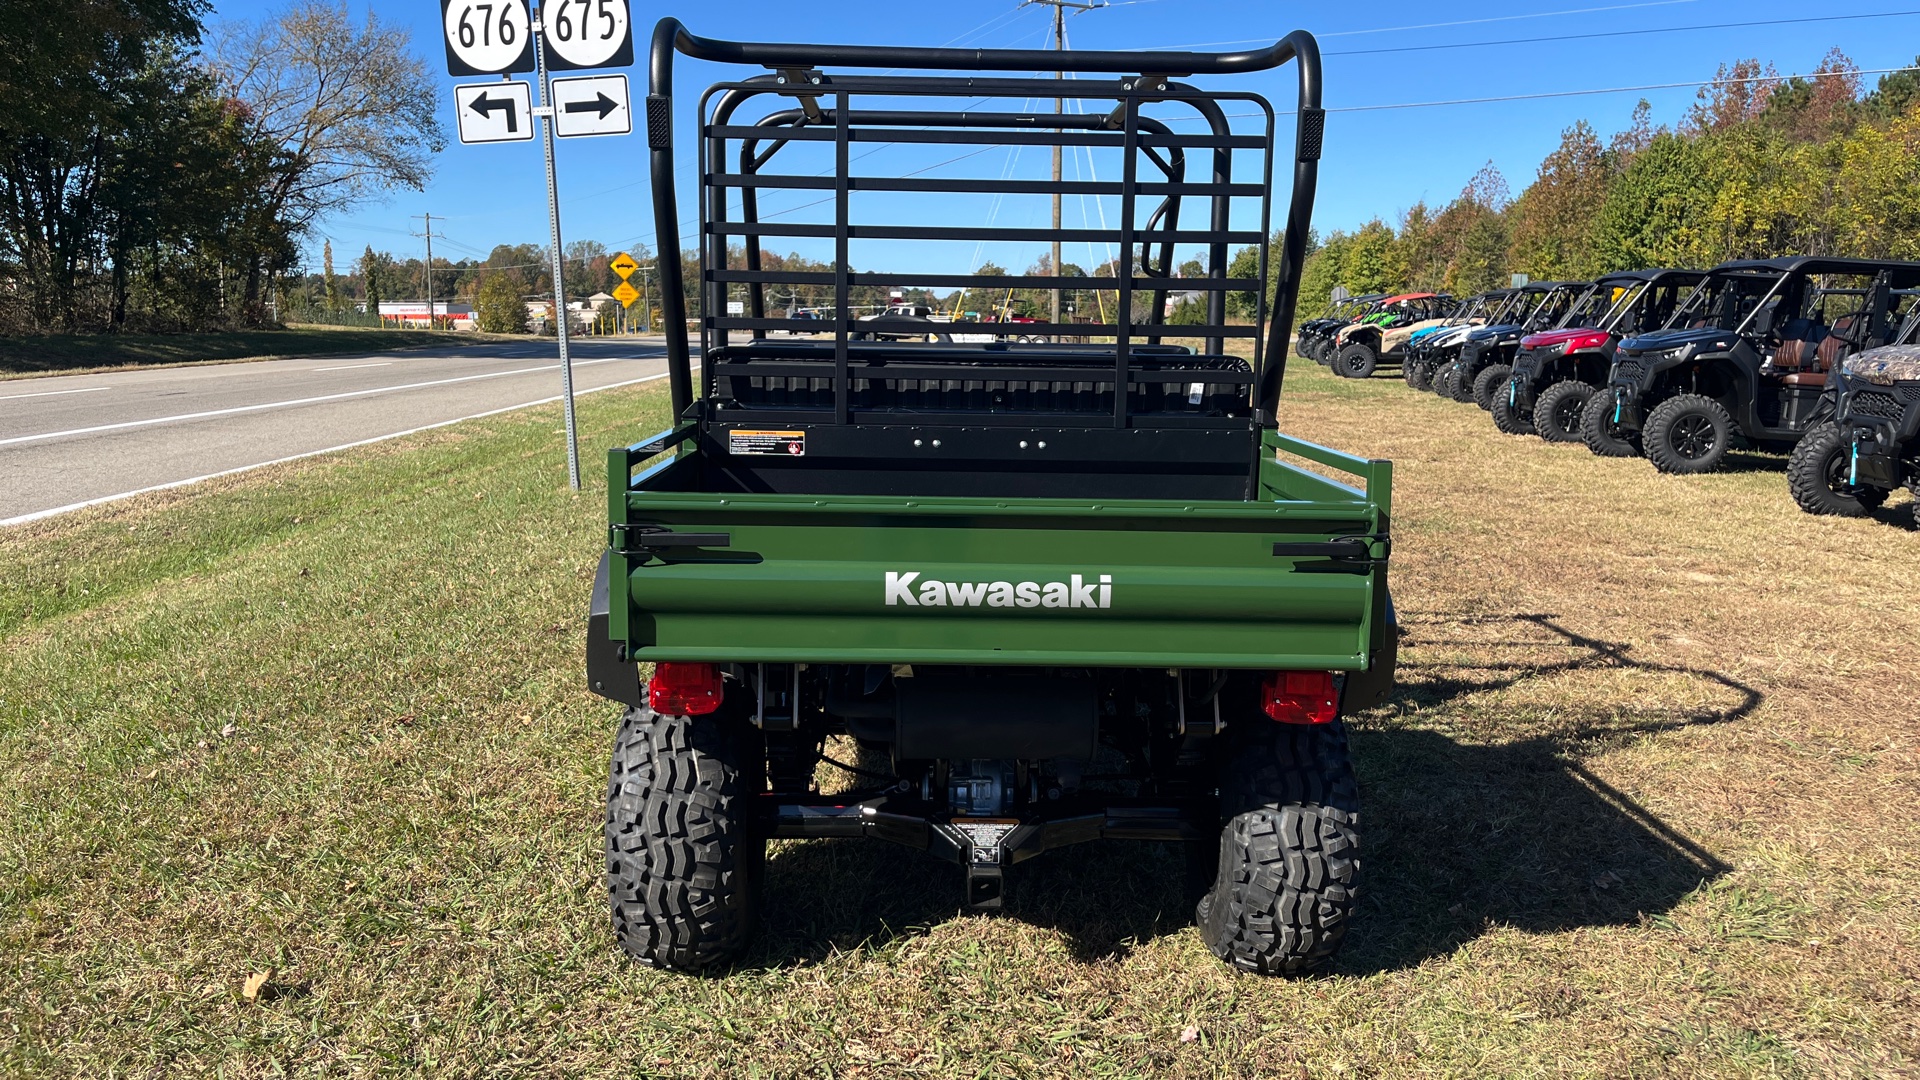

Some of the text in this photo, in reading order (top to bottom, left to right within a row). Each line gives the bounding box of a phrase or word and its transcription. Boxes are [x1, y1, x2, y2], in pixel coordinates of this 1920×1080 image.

[458, 3, 515, 48] 676
[556, 0, 615, 42] 675
[885, 571, 1112, 609] Kawasaki
